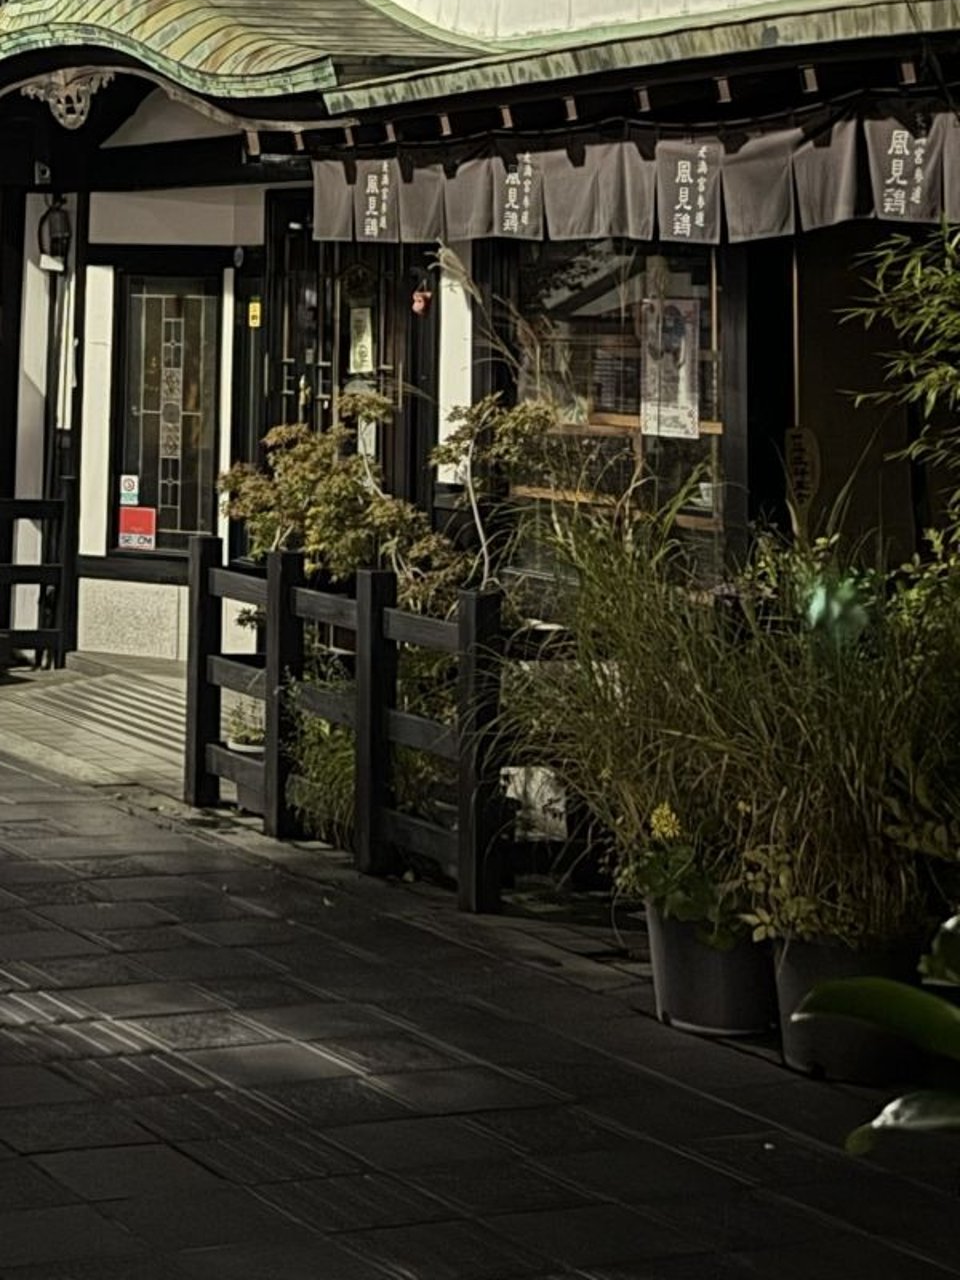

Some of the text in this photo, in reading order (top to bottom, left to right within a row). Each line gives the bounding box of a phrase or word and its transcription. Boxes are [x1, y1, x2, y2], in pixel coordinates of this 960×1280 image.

[672, 160, 694, 237] 風見鶏
[882, 129, 909, 215] 風見鶏
